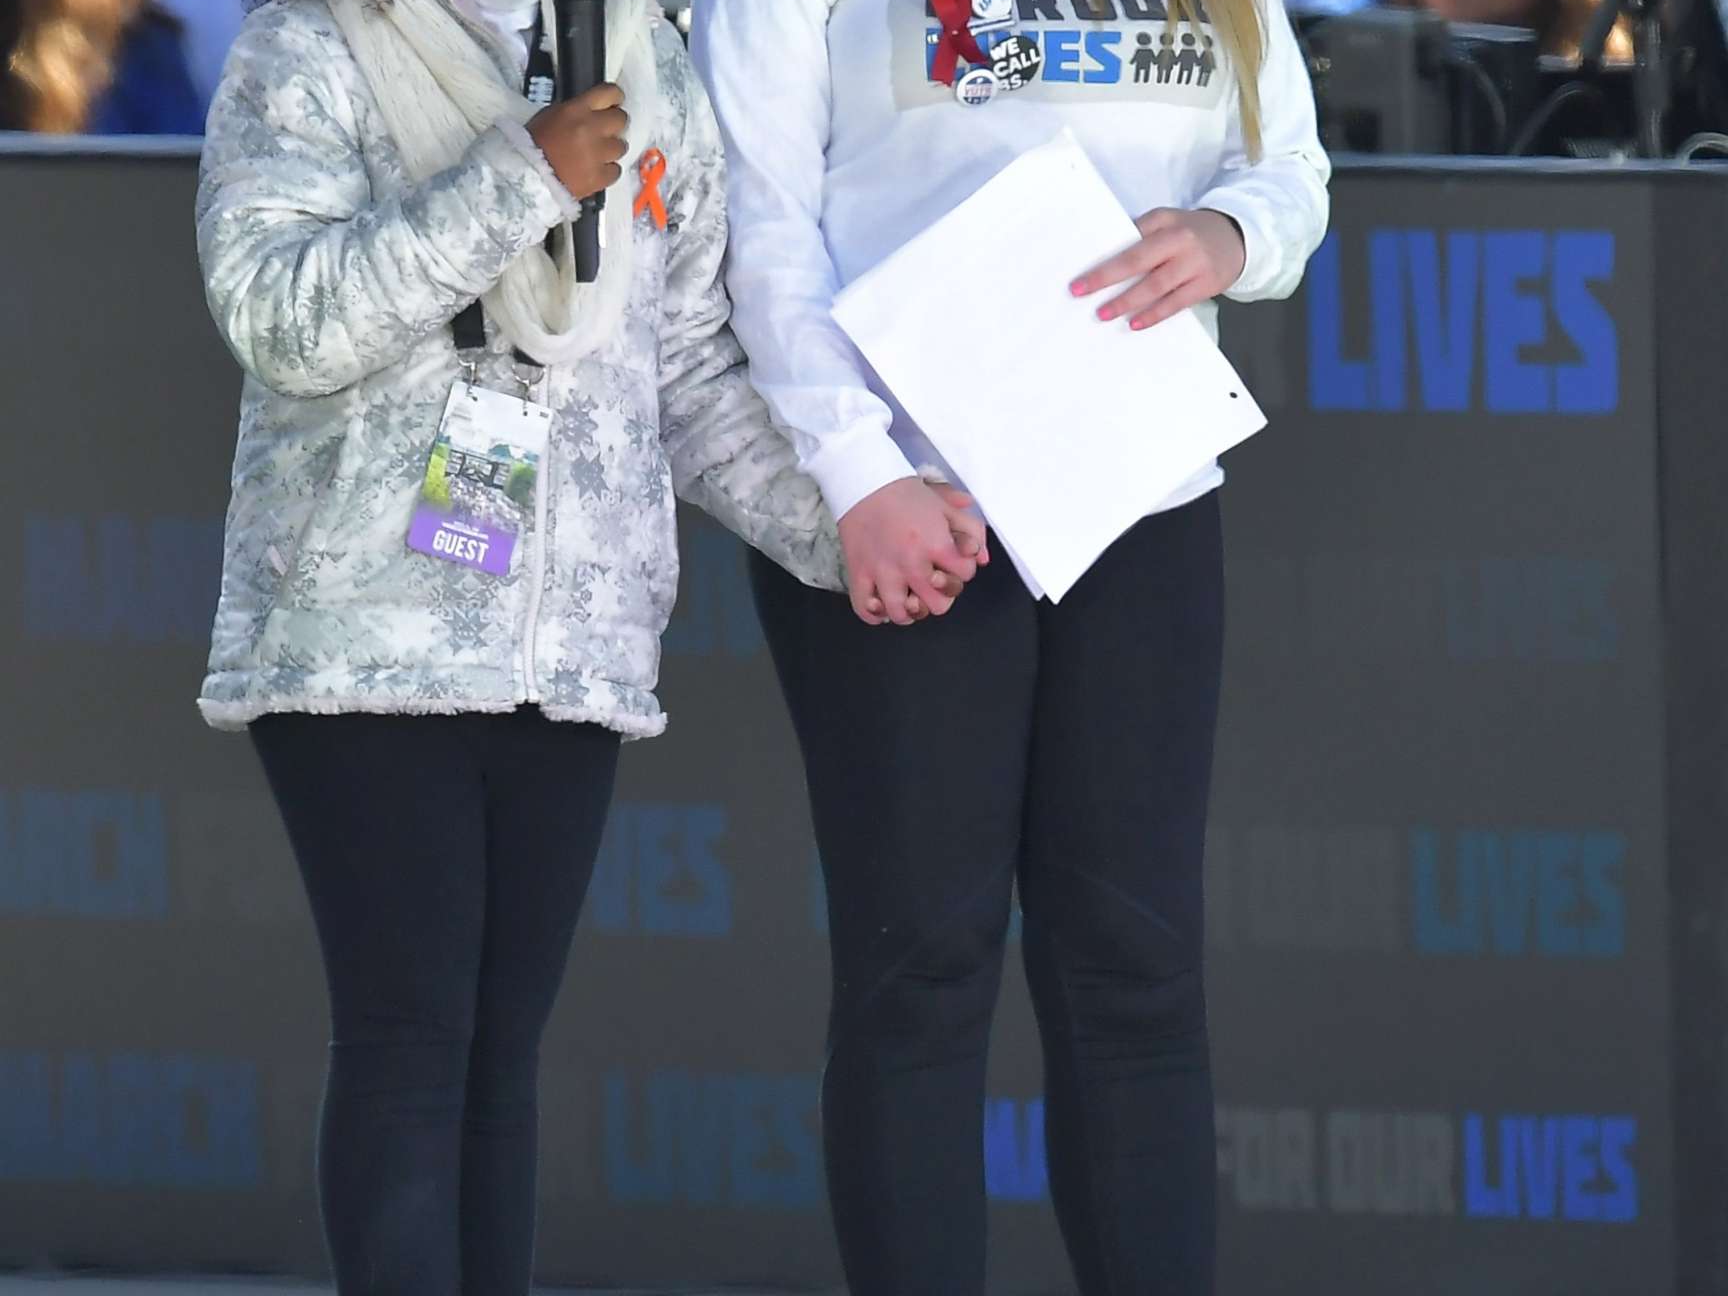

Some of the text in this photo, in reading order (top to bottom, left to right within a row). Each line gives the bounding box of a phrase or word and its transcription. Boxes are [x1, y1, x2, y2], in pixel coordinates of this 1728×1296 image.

[990, 37, 1020, 61] WE
[993, 48, 1041, 78] CALL
[1308, 229, 1620, 415] LIVES
[432, 529, 490, 564] GUEST
[1410, 826, 1628, 957] LIVES
[1461, 1110, 1640, 1224] LIVES
